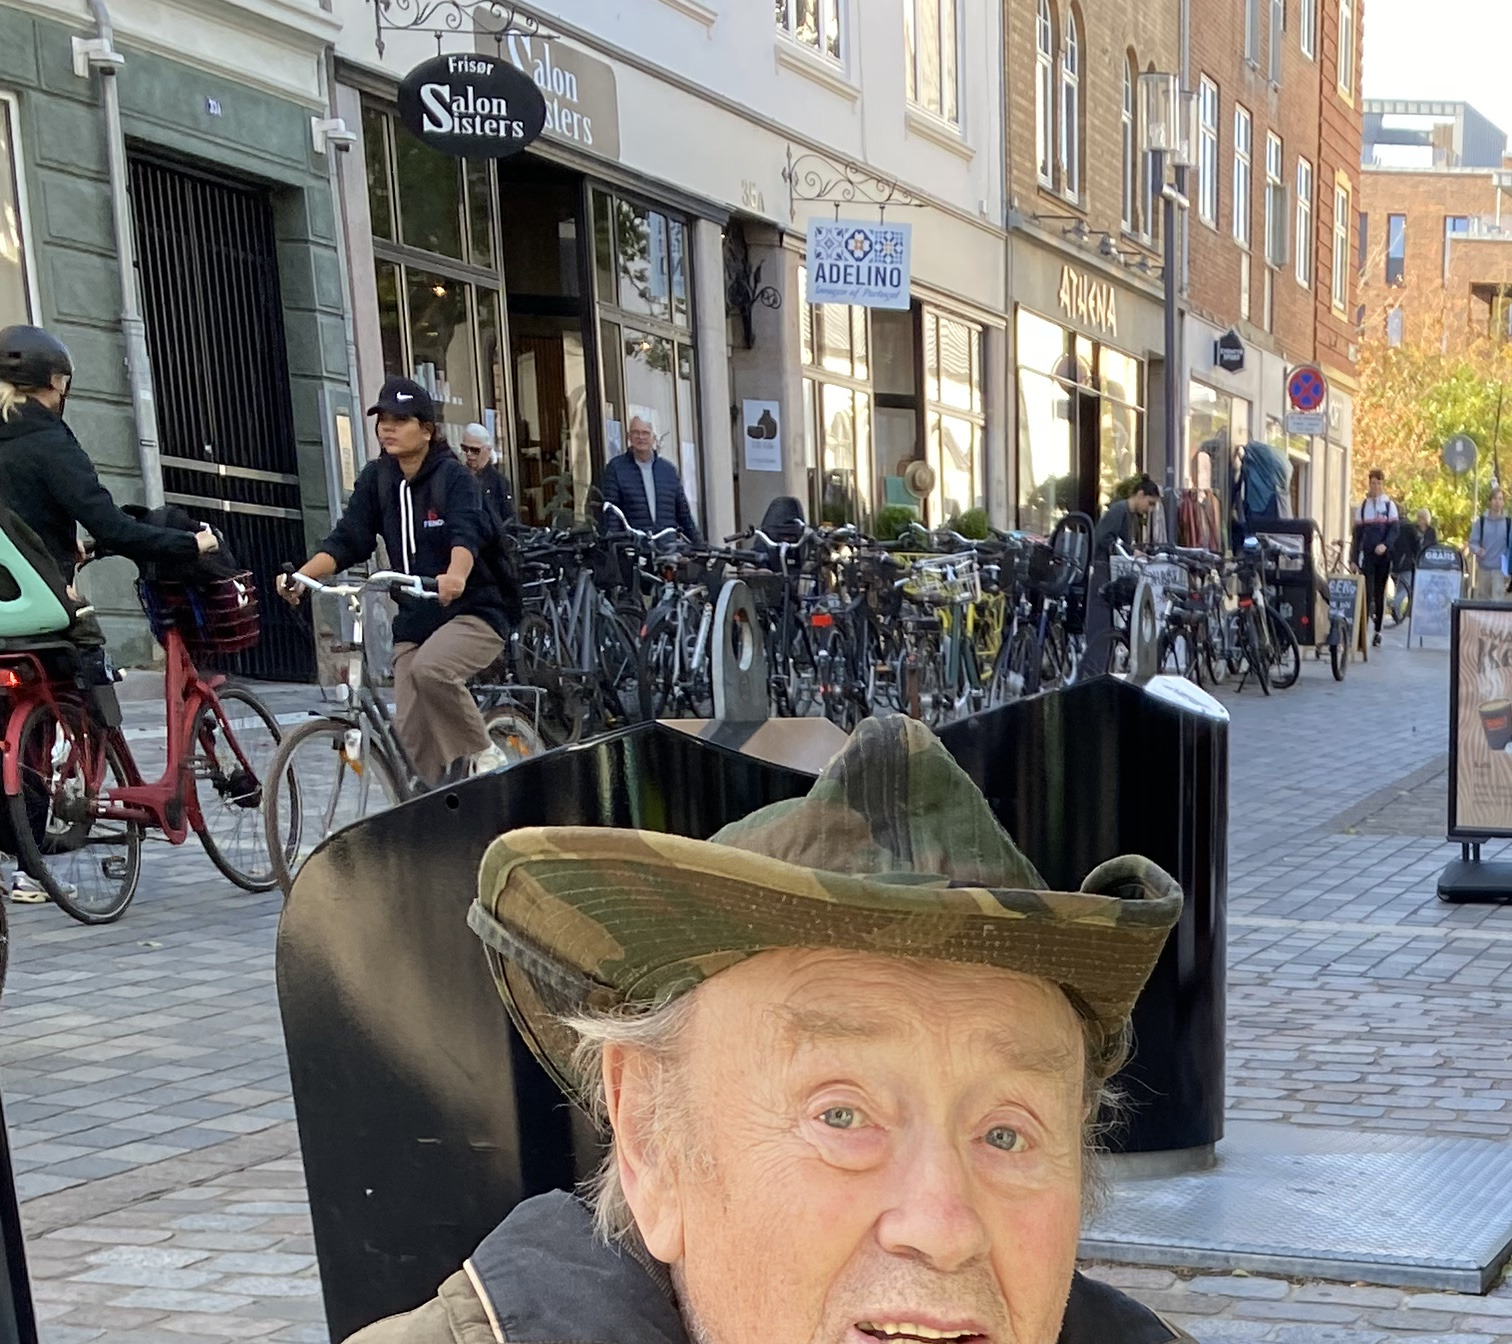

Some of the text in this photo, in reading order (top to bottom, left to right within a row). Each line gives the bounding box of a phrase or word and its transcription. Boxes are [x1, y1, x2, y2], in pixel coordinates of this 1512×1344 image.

[448, 56, 495, 76] Frisør
[420, 83, 508, 132] Salon
[545, 98, 594, 146] sters
[814, 262, 902, 288] ADELINO
[1059, 265, 1118, 338] ATHENA
